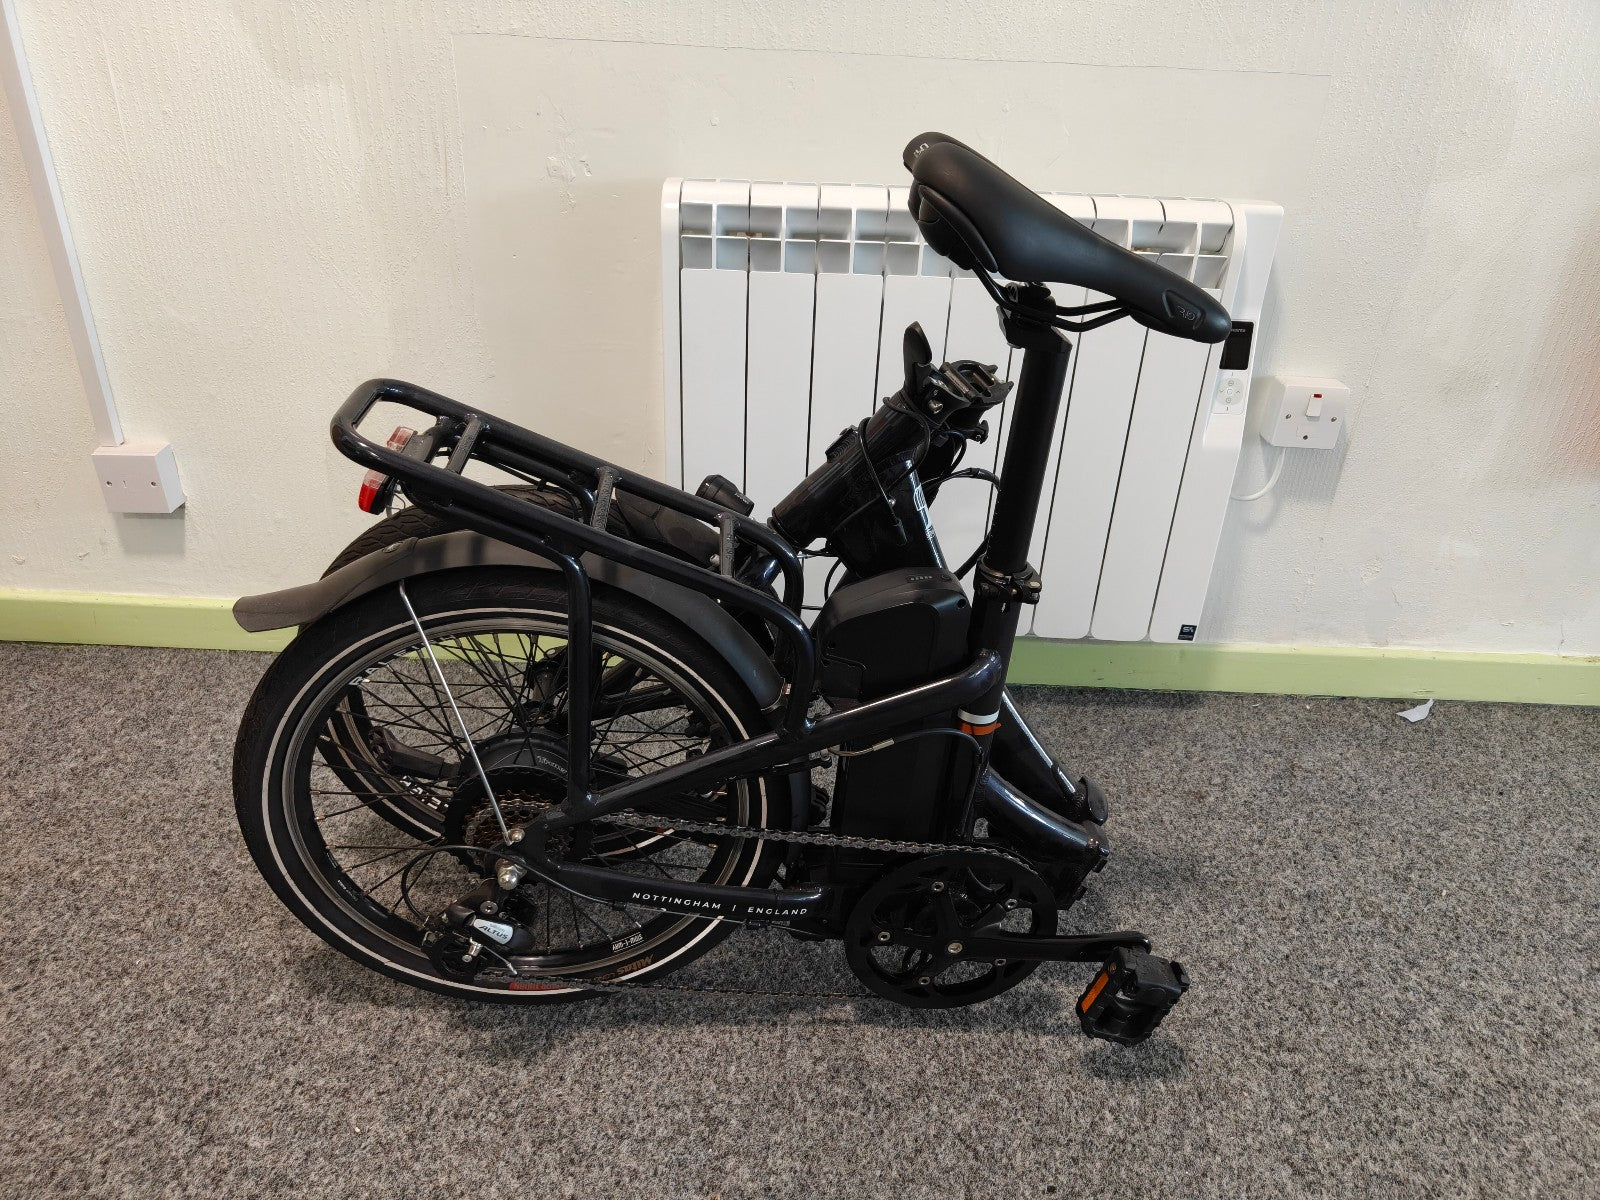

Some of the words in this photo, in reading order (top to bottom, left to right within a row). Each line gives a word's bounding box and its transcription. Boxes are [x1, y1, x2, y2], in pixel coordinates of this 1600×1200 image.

[632, 892, 721, 910] NOTTINGHAM
[747, 906, 808, 915] ENGLAND
[478, 925, 509, 939] ALTUS
